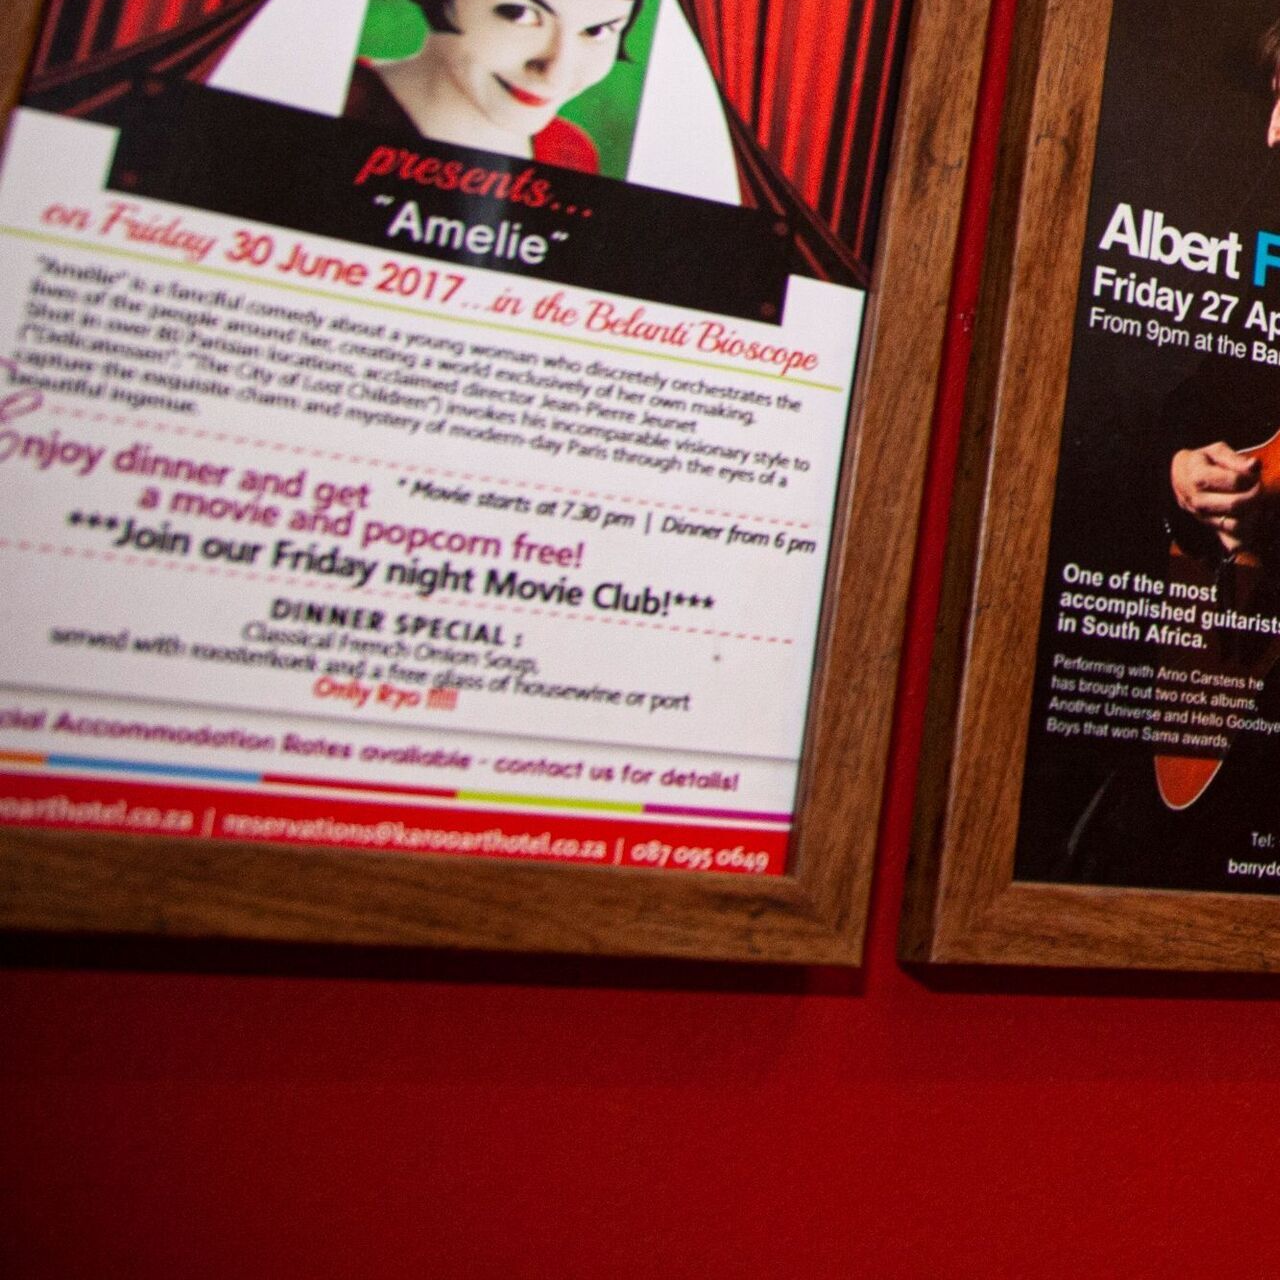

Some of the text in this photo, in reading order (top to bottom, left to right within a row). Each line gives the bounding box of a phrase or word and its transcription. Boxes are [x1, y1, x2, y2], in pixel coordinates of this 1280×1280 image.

[1099, 202, 1241, 281] Albert
[1092, 265, 1193, 323] Friday
[1201, 291, 1238, 325] 27
[1089, 306, 1142, 339] From
[1146, 318, 1189, 351] 9pm
[1194, 330, 1213, 351] at
[1217, 333, 1246, 359] the
[113, 442, 370, 512] dinner and get
[1059, 590, 1196, 624] accomplished
[1063, 562, 1217, 603] One of the most
[1057, 614, 1208, 651] in South Africa.
